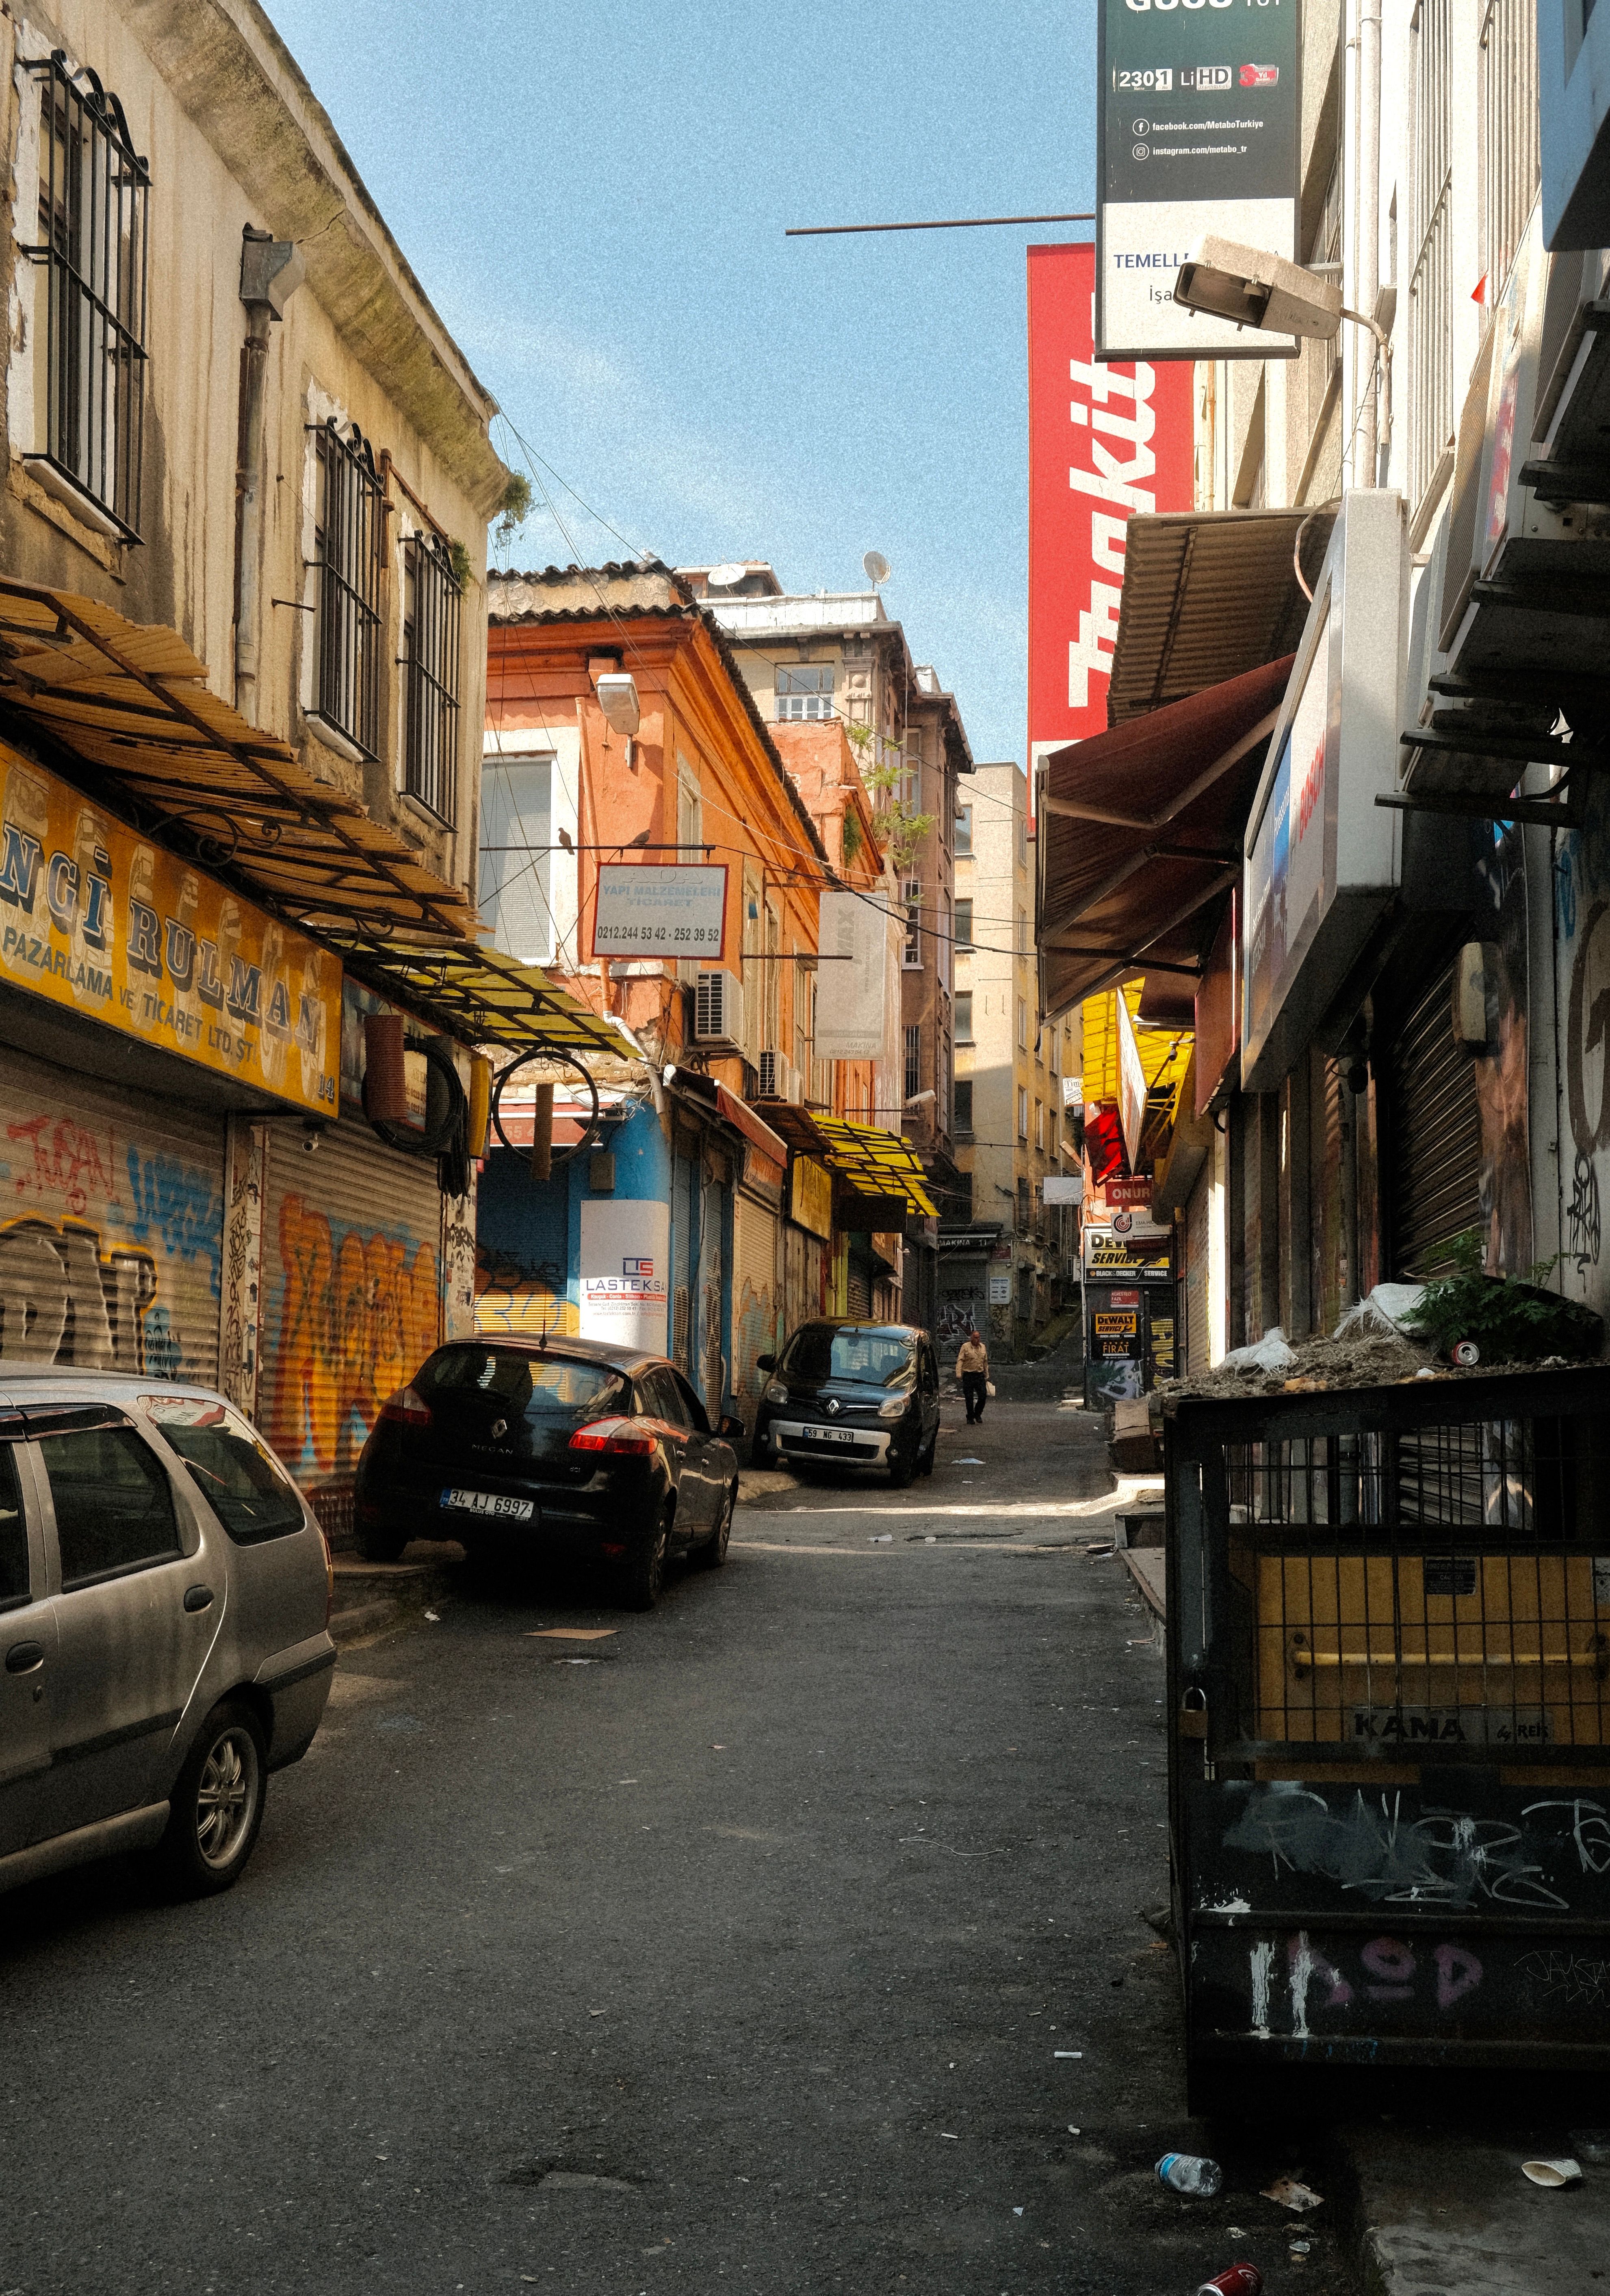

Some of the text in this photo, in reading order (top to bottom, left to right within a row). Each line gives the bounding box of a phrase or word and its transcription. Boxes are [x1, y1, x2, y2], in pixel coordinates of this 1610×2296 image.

[1239, 65, 1255, 87] 3
[1153, 119, 1263, 130] facebook.com/MetaboTurkiye
[1153, 145, 1247, 156] instagram.com/metabo_tr
[1114, 253, 1189, 268] TEMELL
[1300, 729, 1324, 844] BOSCH
[603, 885, 630, 895] YAPI
[598, 926, 638, 939] 0212.244
[641, 927, 652, 940] 53
[655, 927, 666, 940] 42
[674, 928, 691, 941] 252
[694, 928, 705, 941] 39
[708, 929, 719, 942] 52
[126, 896, 322, 1055] RULMAN
[3, 926, 113, 1001] PAZARLAMA
[119, 985, 134, 1010] VE
[143, 992, 203, 1043] TİCARET
[318, 1072, 335, 1105] 14
[1112, 1187, 1150, 1199] ONUR
[1103, 1345, 1129, 1353] FIRAT
[808, 1429, 852, 1441] 59 NG 433
[450, 1491, 466, 1506] 34
[471, 1493, 489, 1509] AJ
[494, 1497, 530, 1515] 6997
[1354, 1713, 1466, 1741] KAMA
